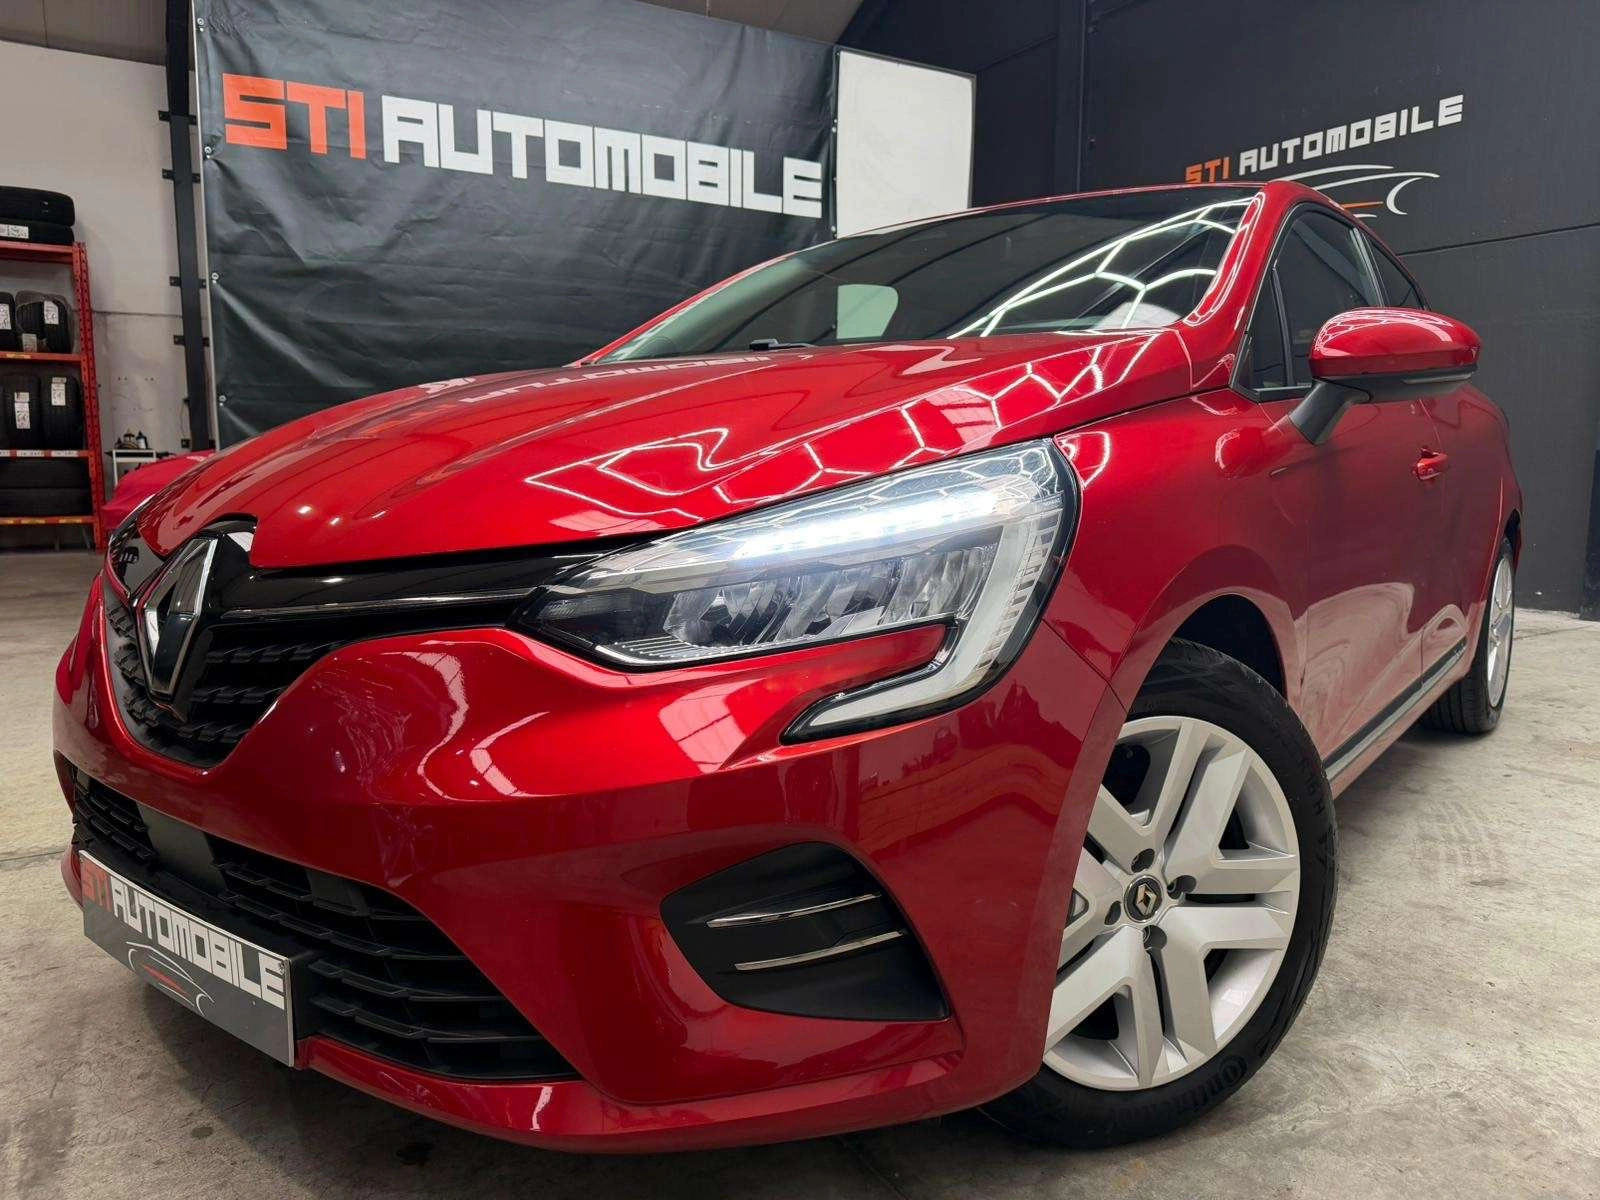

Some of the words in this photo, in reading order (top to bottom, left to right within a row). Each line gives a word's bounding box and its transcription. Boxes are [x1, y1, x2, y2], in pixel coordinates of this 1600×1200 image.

[222, 73, 366, 159] STI
[382, 95, 822, 219] AUTOMOBILE
[1185, 156, 1230, 184] STI
[1239, 94, 1464, 176] AUTOMOBILE
[80, 858, 113, 913] STI
[110, 876, 285, 1010] AUTOMOBILE
